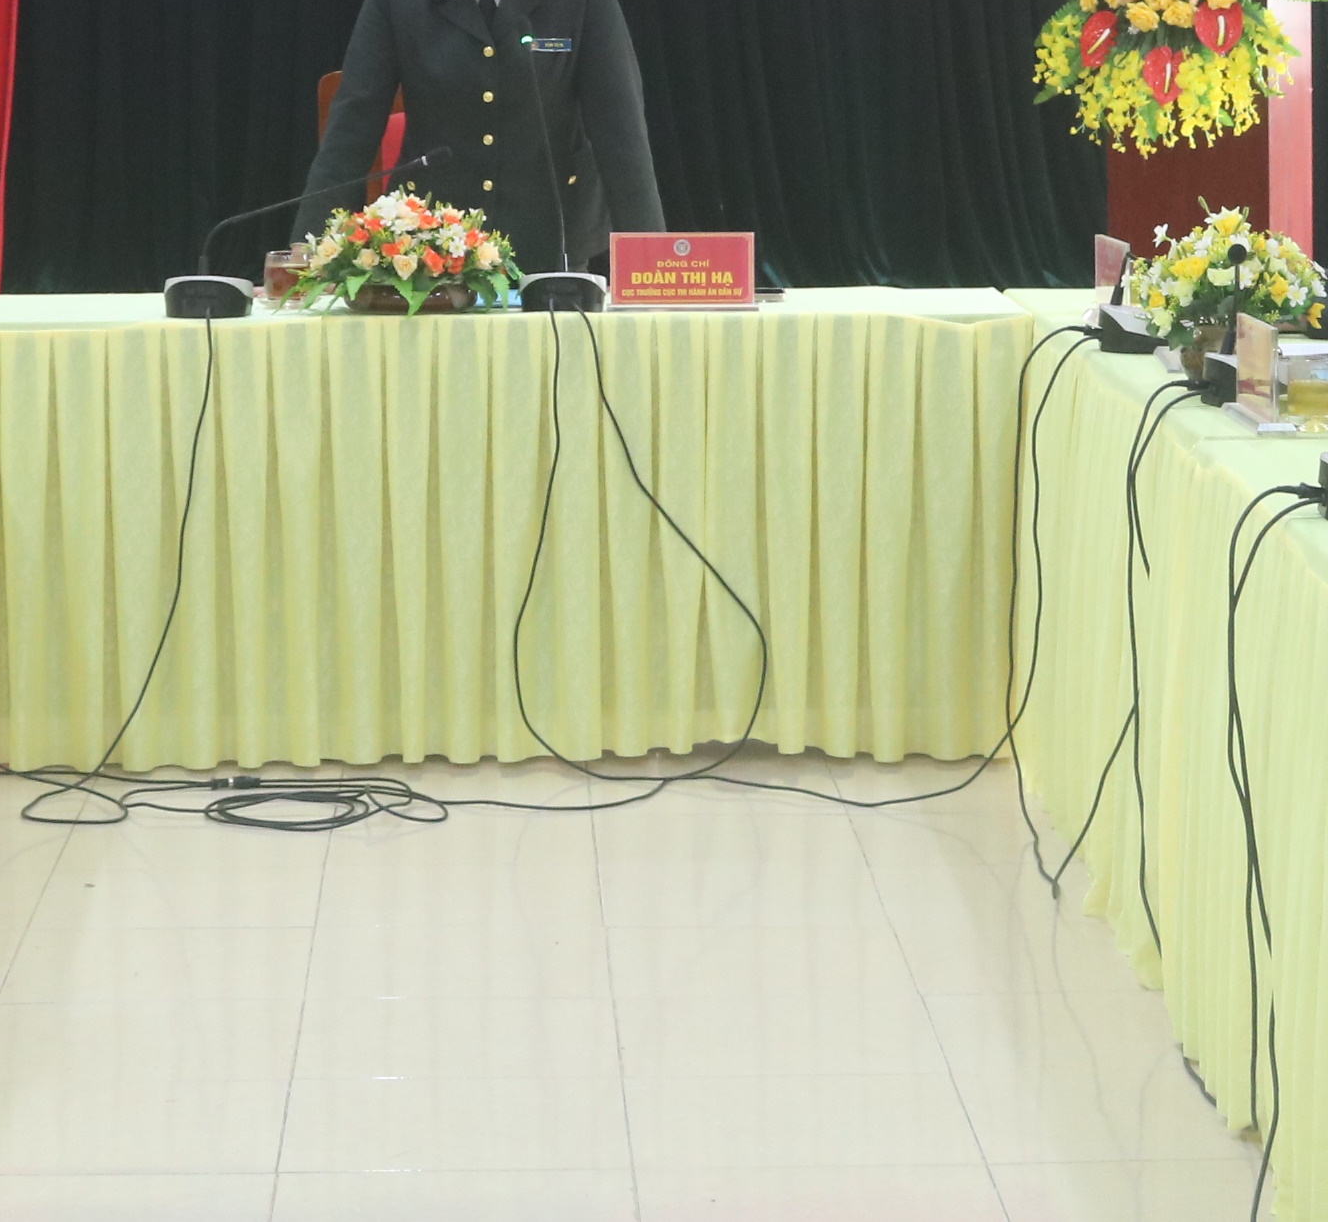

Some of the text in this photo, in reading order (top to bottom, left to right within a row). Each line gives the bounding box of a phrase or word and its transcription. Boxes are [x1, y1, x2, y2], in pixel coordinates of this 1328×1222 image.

[631, 269, 734, 286] ĐOÀN THỊ HẠ
